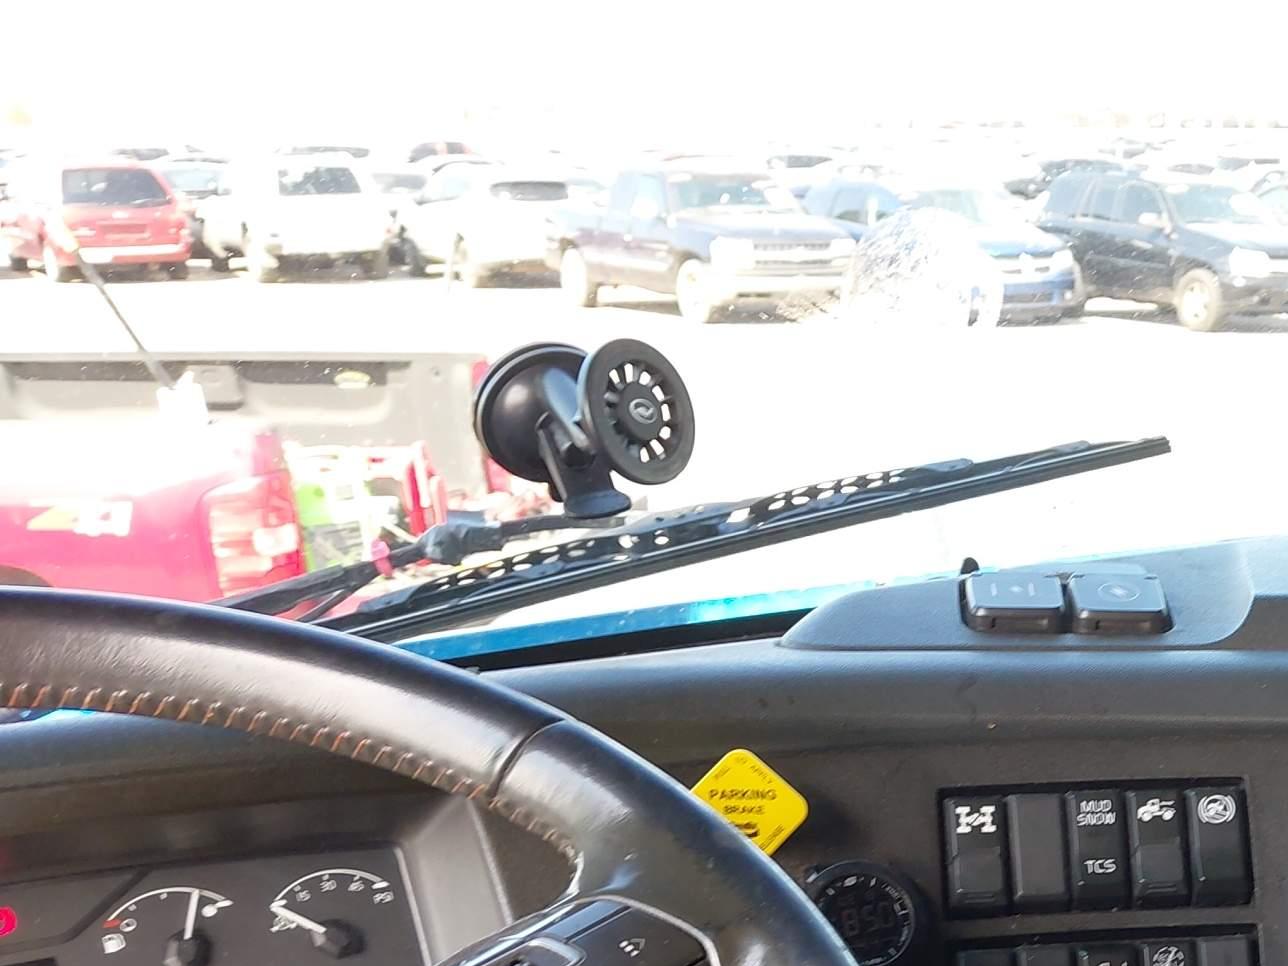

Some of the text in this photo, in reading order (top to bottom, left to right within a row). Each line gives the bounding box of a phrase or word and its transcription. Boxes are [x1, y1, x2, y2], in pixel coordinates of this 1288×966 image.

[709, 789, 777, 800] PARKING
[723, 805, 765, 815] BRAKE
[1079, 800, 1112, 812] MUD
[1077, 813, 1116, 826] SNOW
[1083, 859, 1117, 874] TCS
[320, 880, 337, 892] 30
